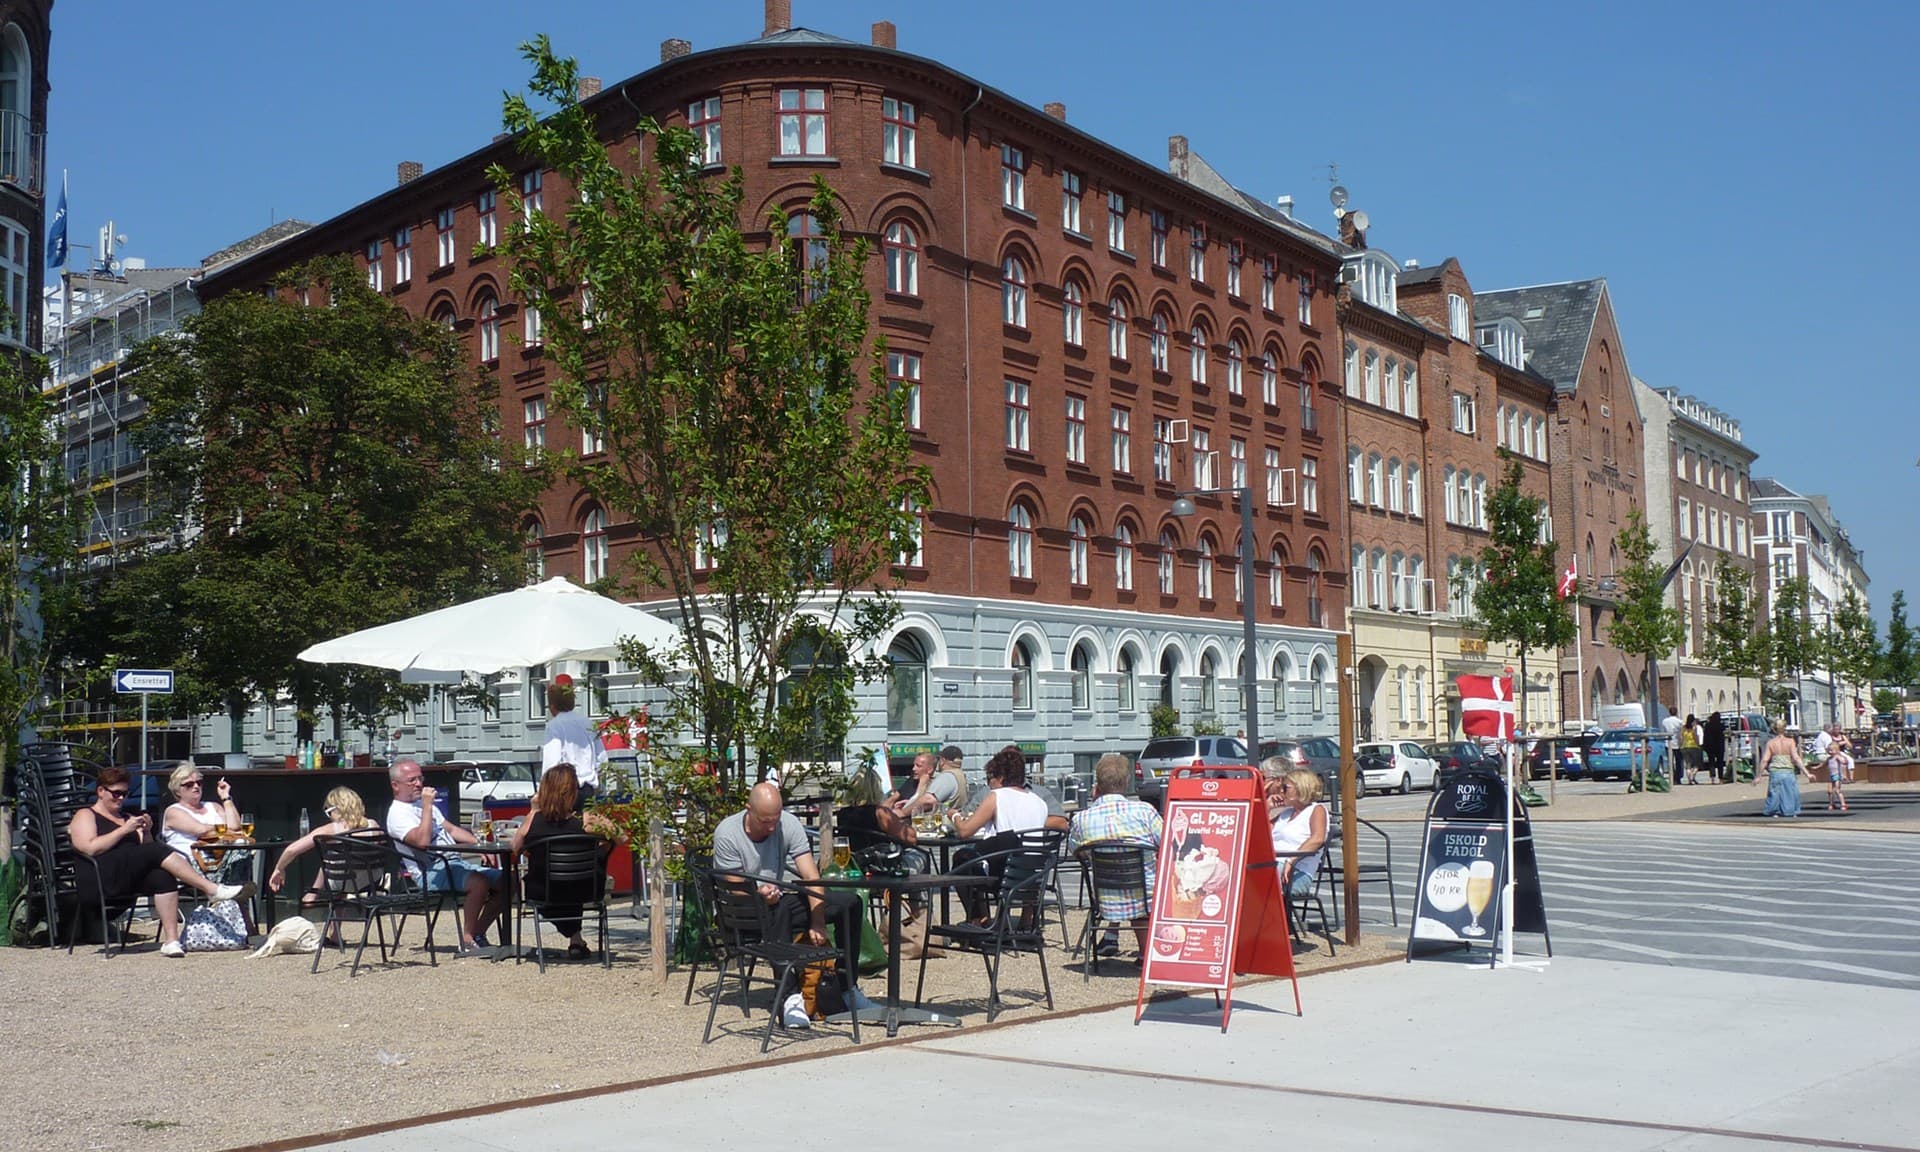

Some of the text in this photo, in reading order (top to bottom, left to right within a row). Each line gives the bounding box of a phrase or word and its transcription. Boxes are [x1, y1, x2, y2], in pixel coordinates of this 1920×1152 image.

[1456, 784, 1488, 795] ROYAL
[1190, 811, 1235, 829] Gl. Dags
[1444, 834, 1487, 846] ISKOLD
[1435, 870, 1460, 880] STOR
